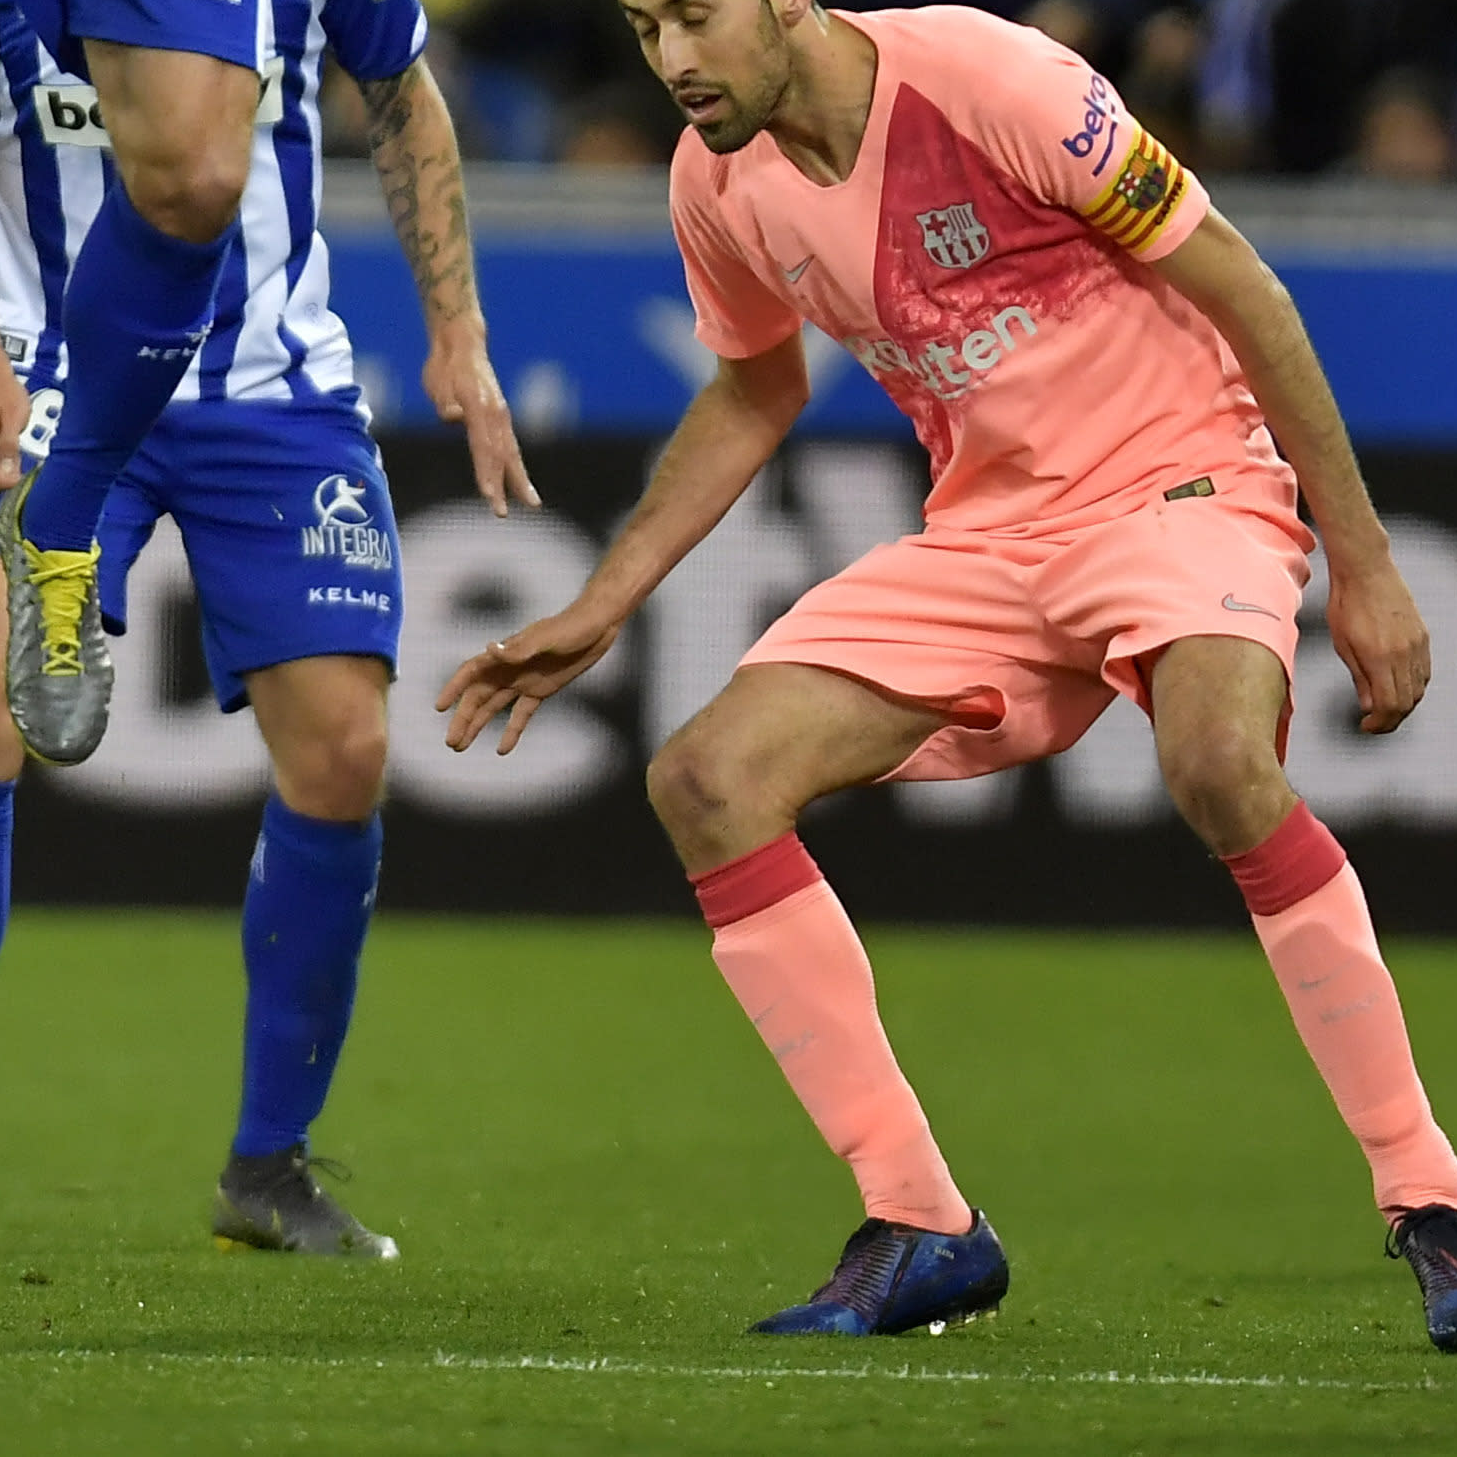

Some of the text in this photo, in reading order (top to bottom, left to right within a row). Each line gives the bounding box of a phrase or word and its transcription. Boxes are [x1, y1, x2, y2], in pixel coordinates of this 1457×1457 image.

[844, 305, 1038, 385] Raten
[302, 526, 391, 568] INTEGRA
[309, 587, 390, 612] KELME
